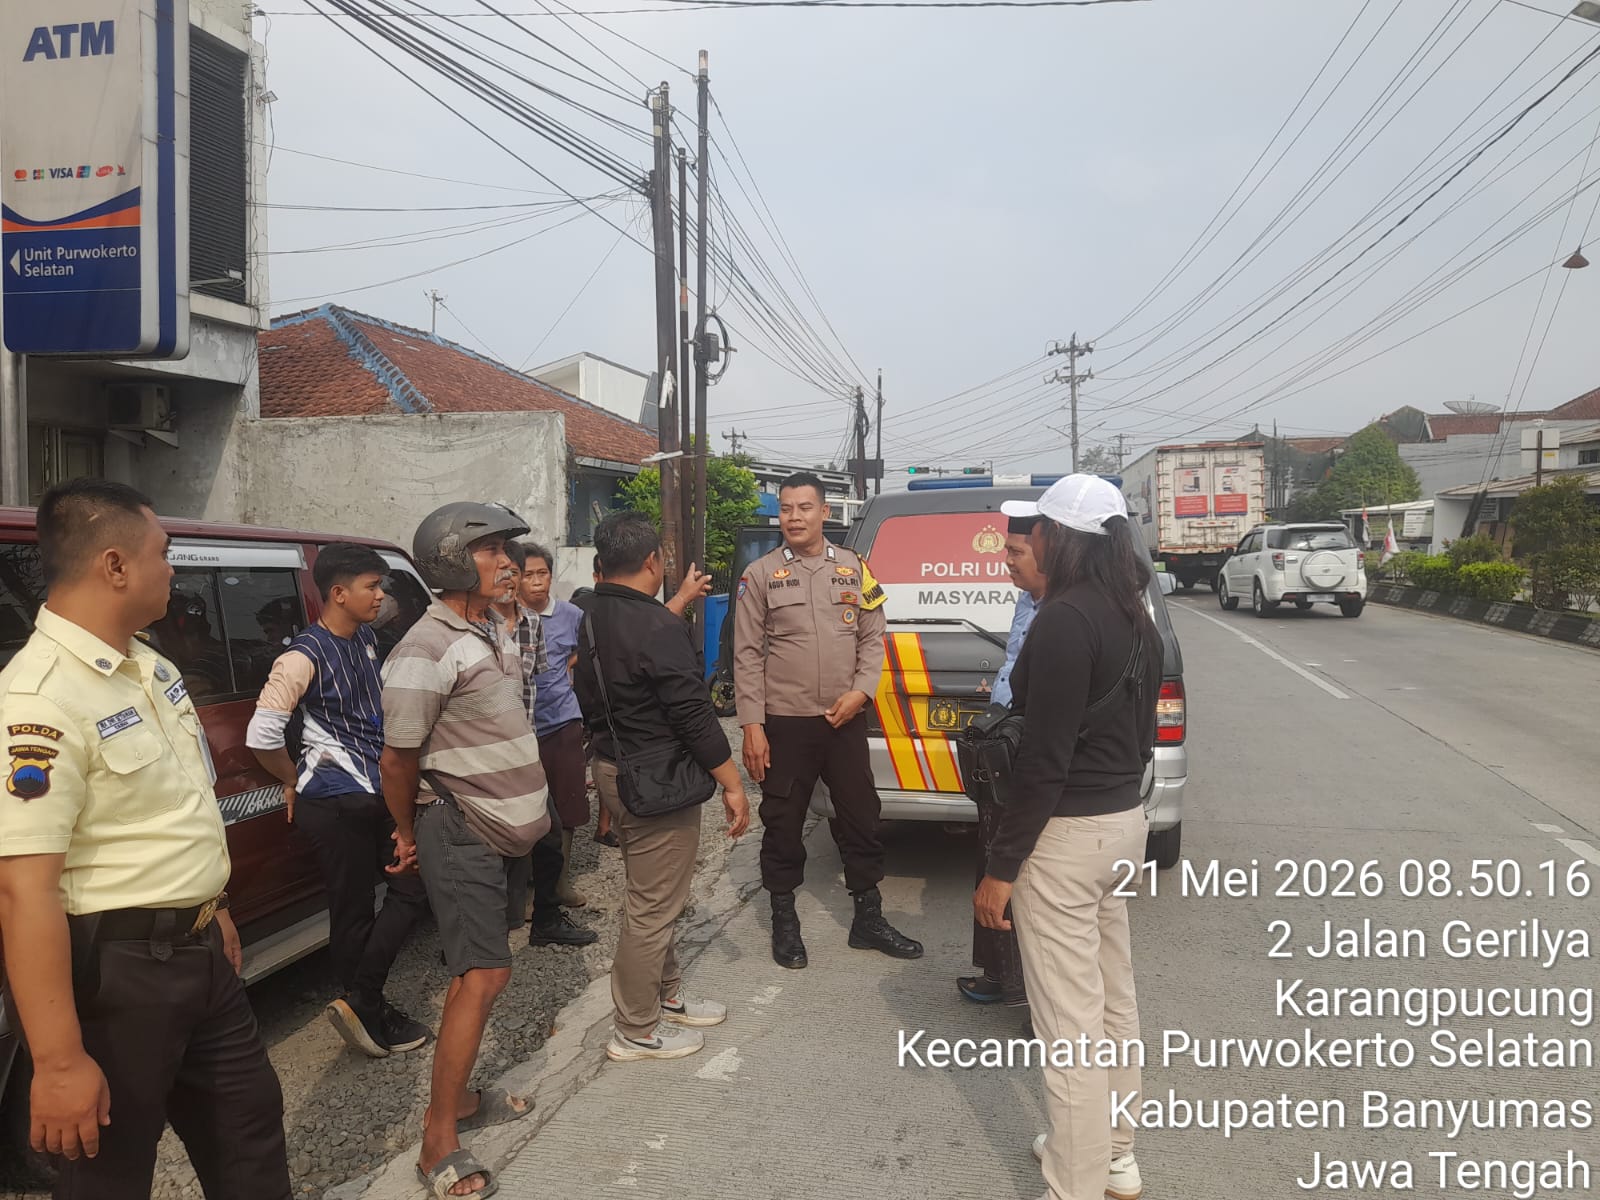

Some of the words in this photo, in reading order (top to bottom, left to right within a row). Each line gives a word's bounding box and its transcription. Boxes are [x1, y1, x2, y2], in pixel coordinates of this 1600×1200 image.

[22, 20, 115, 62] ATM
[49, 167, 74, 179] VISA
[24, 246, 52, 261] Unit
[57, 244, 137, 260] Purwokerto
[24, 262, 74, 277] Selatan
[921, 562, 979, 577] POLRI
[986, 562, 1012, 577] UN
[831, 577, 858, 586] POLRI
[918, 590, 1021, 605] MASYARA
[12, 724, 58, 739] POLDA
